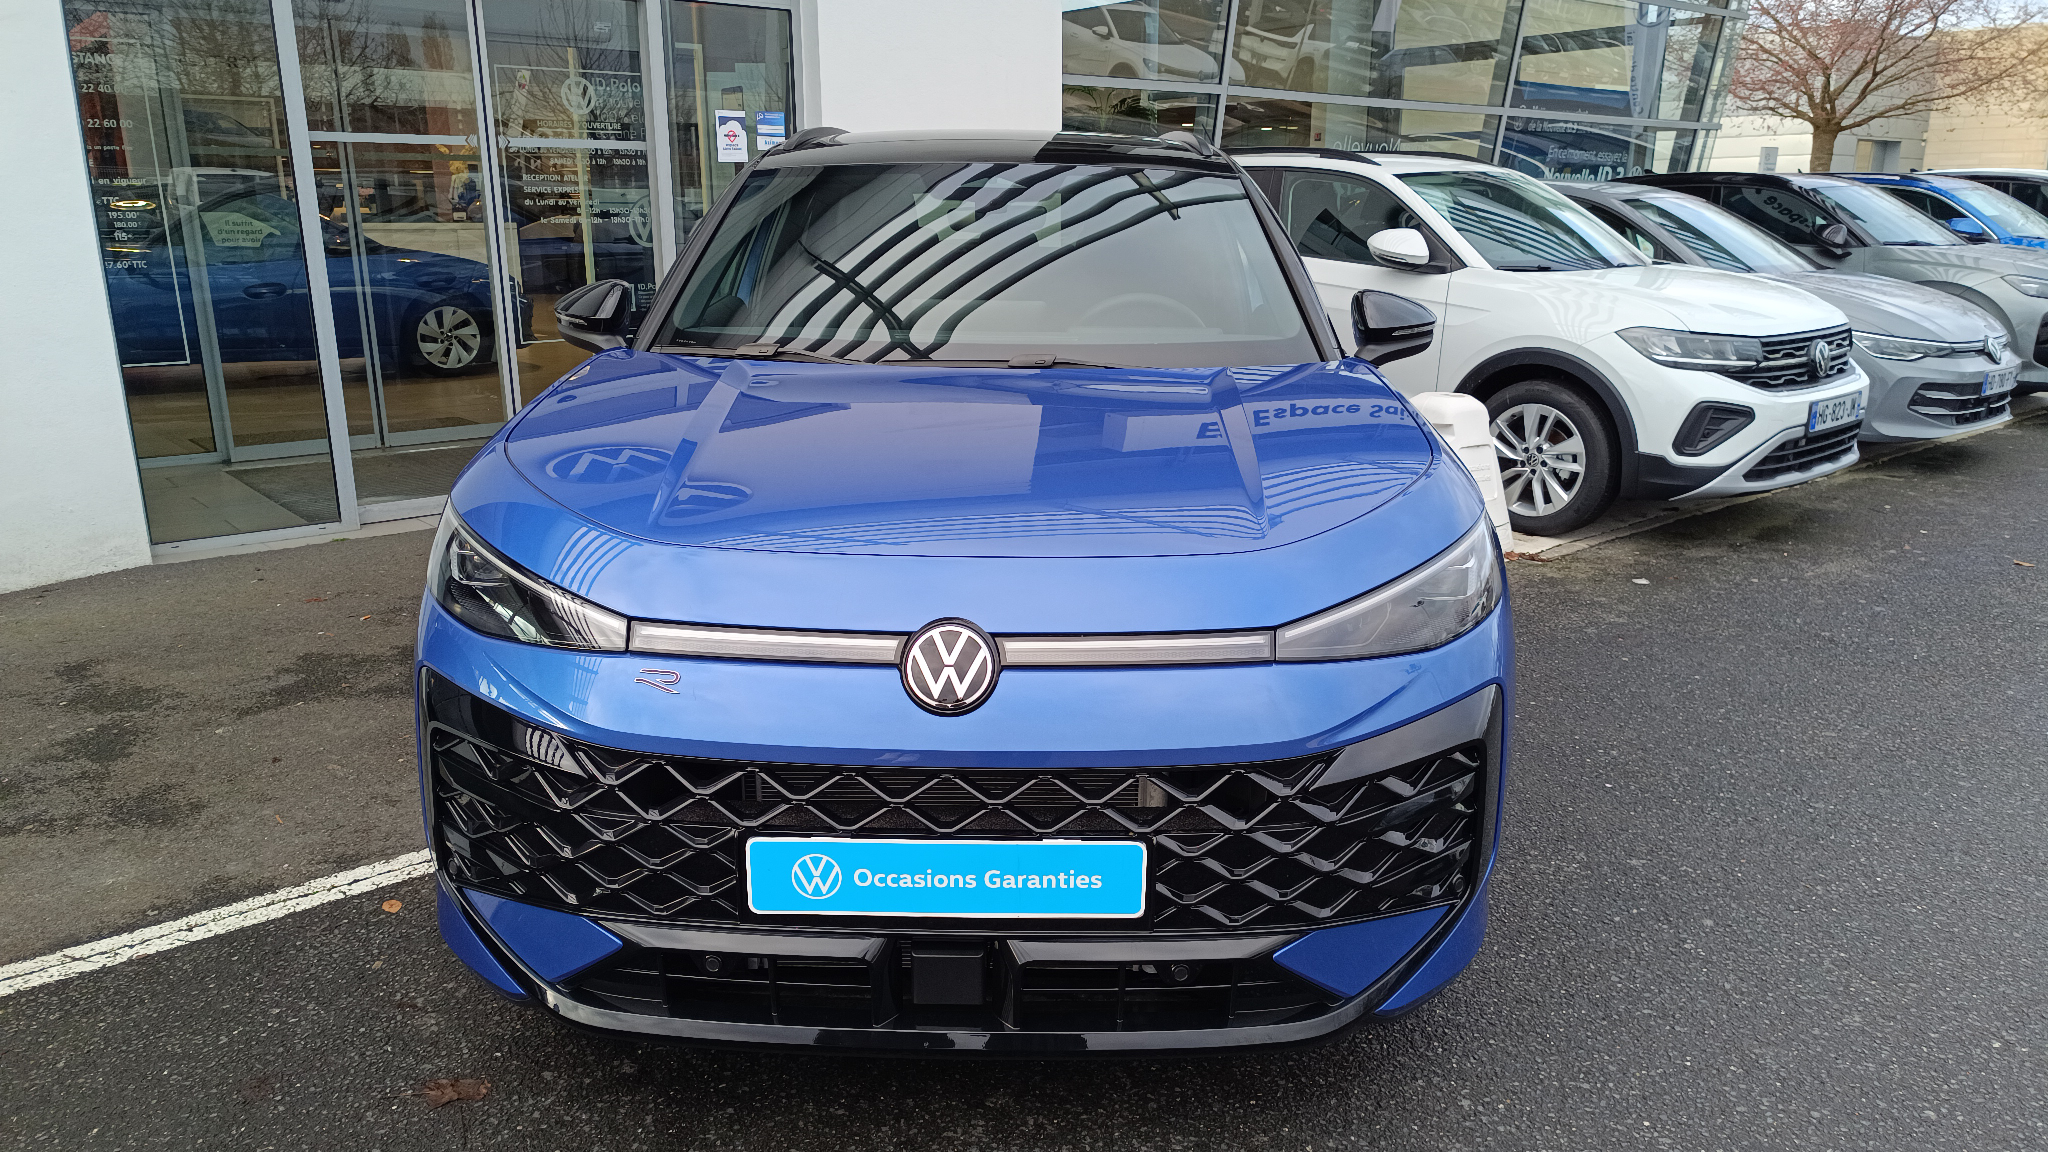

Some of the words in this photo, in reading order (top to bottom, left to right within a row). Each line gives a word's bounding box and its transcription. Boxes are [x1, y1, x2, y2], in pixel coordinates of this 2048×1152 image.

[86, 118, 102, 128] 22
[103, 119, 117, 128] 60
[112, 176, 147, 187] vigueur
[553, 186, 584, 194] EXPRES
[535, 198, 556, 206] Lundi
[237, 228, 263, 237] regard
[853, 867, 977, 889] Occasions
[983, 868, 1103, 890] Garanties
